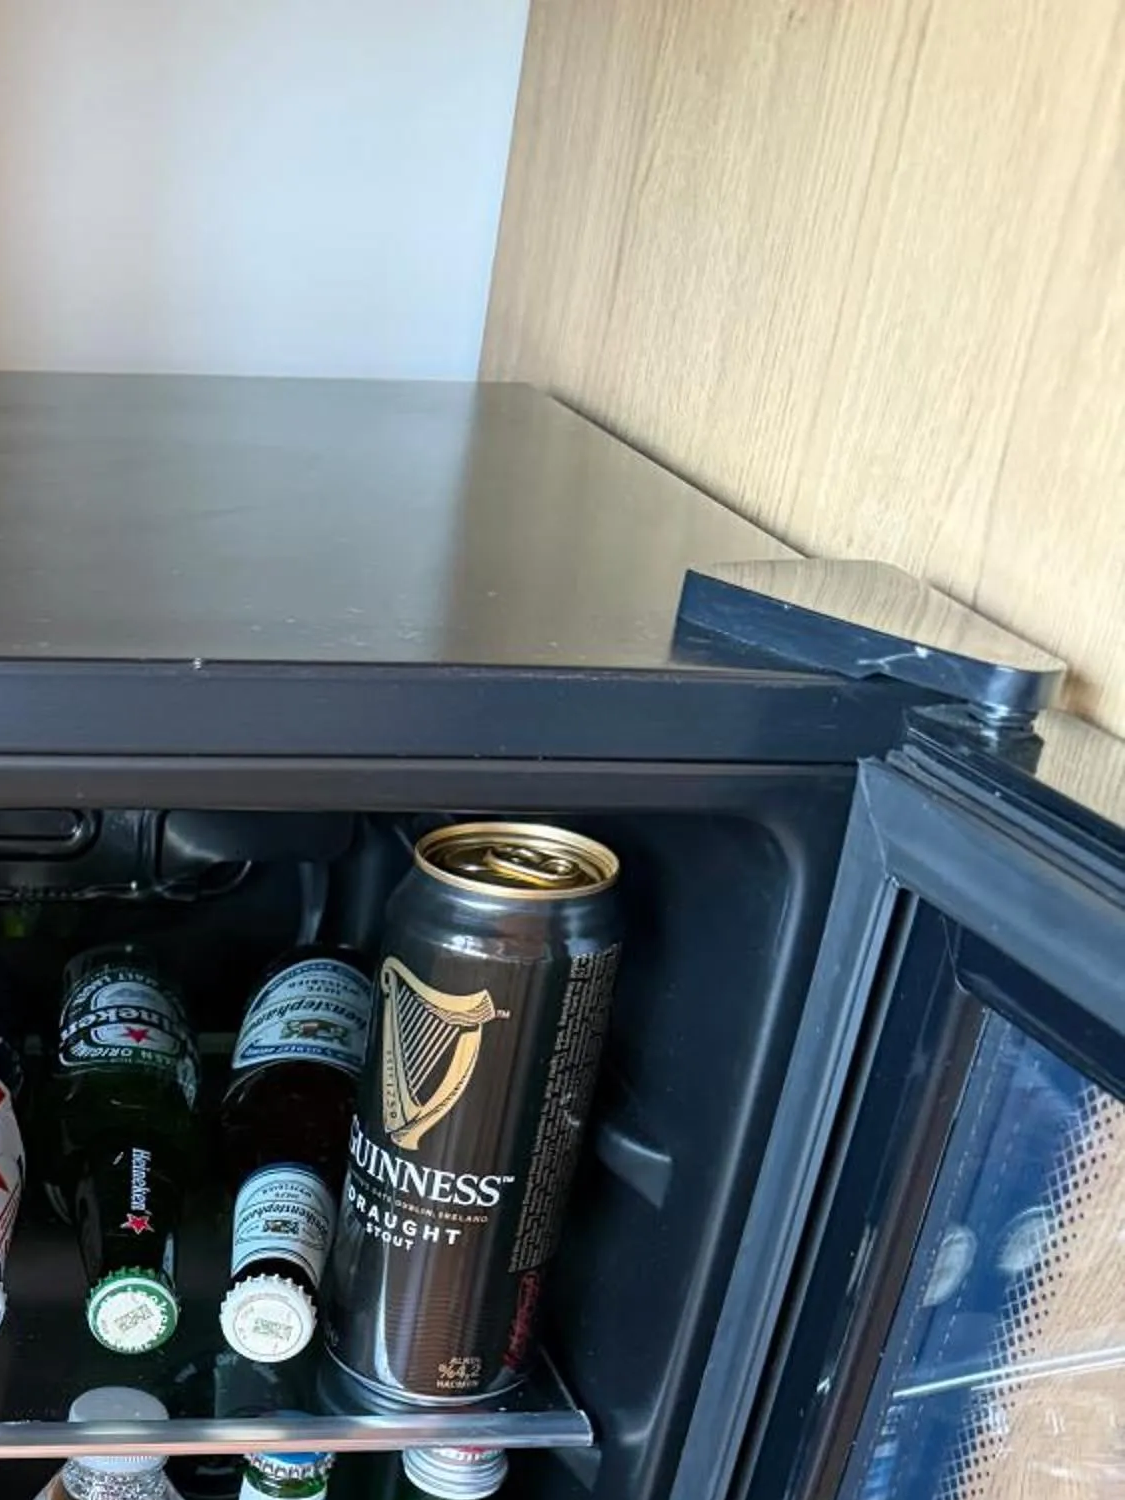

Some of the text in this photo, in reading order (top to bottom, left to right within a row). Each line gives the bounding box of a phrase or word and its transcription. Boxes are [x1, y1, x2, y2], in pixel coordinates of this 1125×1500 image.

[130, 1147, 152, 1211] Heineken
[348, 1184, 462, 1246] DRAUGHT
[365, 1223, 416, 1251] STOUT
